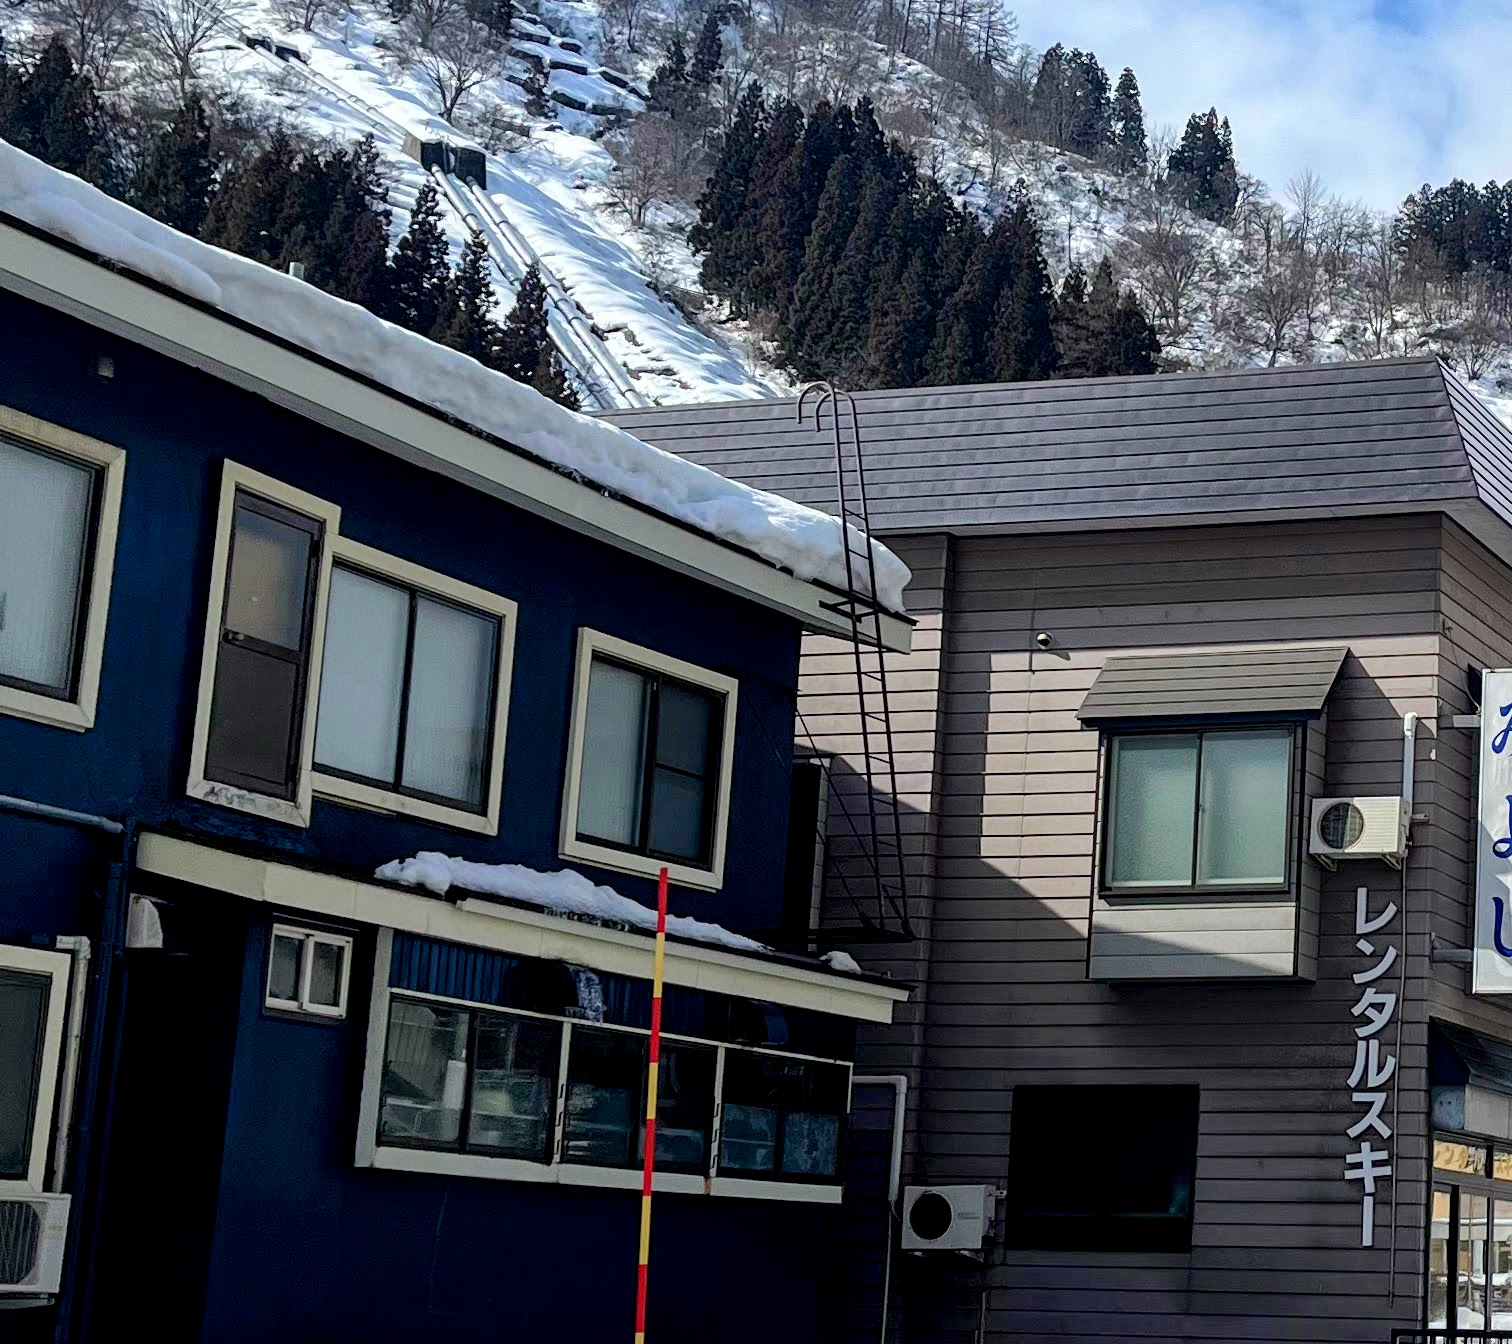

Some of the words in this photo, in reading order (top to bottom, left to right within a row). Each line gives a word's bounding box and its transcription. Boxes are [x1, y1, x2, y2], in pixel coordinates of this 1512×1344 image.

[1344, 885, 1398, 1249] レンタルスキー
